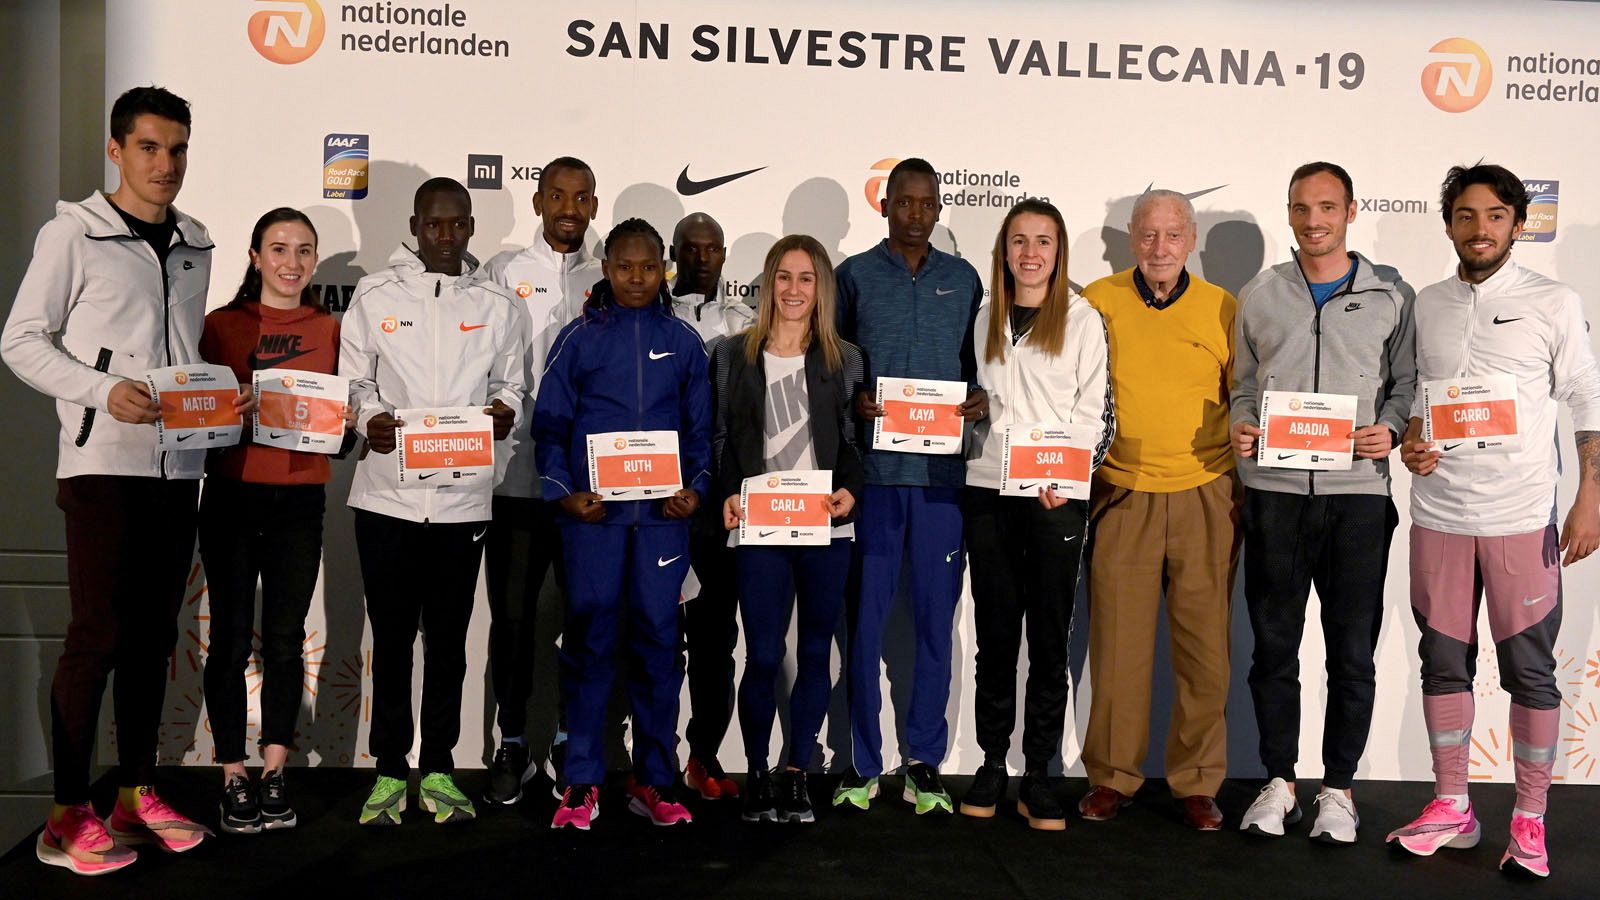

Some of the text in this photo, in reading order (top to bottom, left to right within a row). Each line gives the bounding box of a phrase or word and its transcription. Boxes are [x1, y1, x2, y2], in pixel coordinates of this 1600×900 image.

[341, 1, 466, 27] nationale
[341, 29, 509, 57] nederlanden
[566, 19, 669, 60] SAN
[690, 24, 966, 72] SILVESTRE
[327, 137, 359, 147] IAAF
[328, 168, 365, 177] Road Race
[511, 166, 542, 180] xia
[327, 176, 351, 185] GOLD
[1523, 183, 1550, 193] AAF
[942, 189, 1050, 208] ederlandn
[1360, 198, 1427, 213] xiaomi
[1525, 221, 1541, 229] OLD
[256, 334, 302, 354] NIKE
[182, 396, 216, 412] MATEO
[294, 400, 308, 420] 5
[909, 407, 935, 421] KAYA
[1453, 407, 1491, 423] CARRO
[198, 418, 206, 426] 11
[1289, 421, 1330, 437] ABADIA
[1469, 427, 1476, 436] 6
[412, 437, 483, 453] BUSHENDICH
[1306, 440, 1312, 448] 7
[444, 457, 454, 466] 12
[1036, 452, 1063, 465] SARA
[624, 460, 652, 473] RUTH
[771, 498, 805, 512] CARLA
[785, 516, 791, 525] 3
